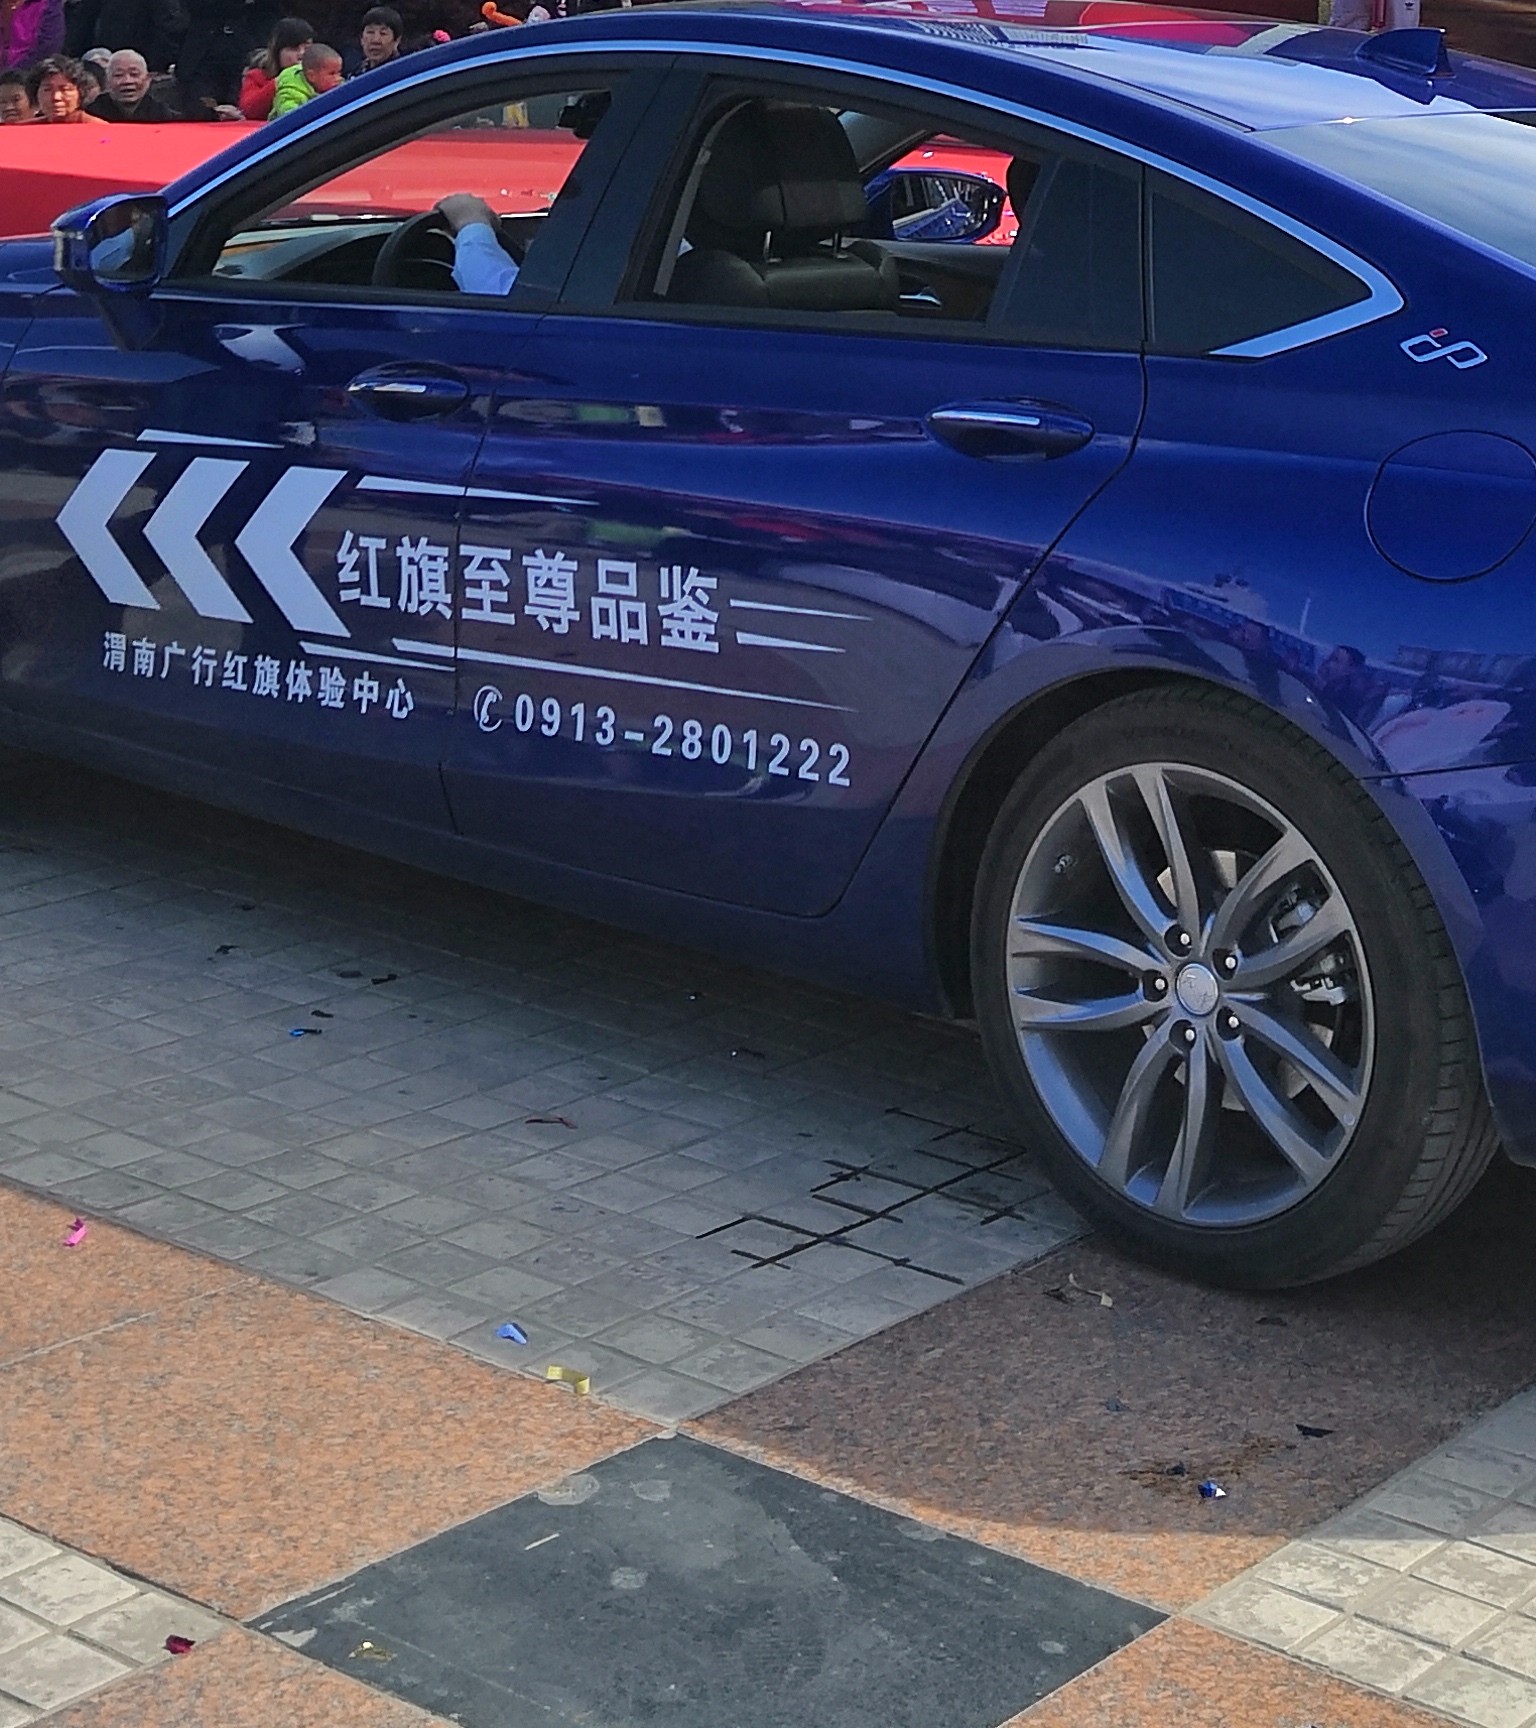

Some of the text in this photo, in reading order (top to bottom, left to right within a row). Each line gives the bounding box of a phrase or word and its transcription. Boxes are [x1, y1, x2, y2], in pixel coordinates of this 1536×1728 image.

[335, 530, 720, 654] 红旗至尊品鉴
[102, 631, 414, 720] 渭南广行红旗体验中心
[514, 692, 853, 787] 0913-2801222
